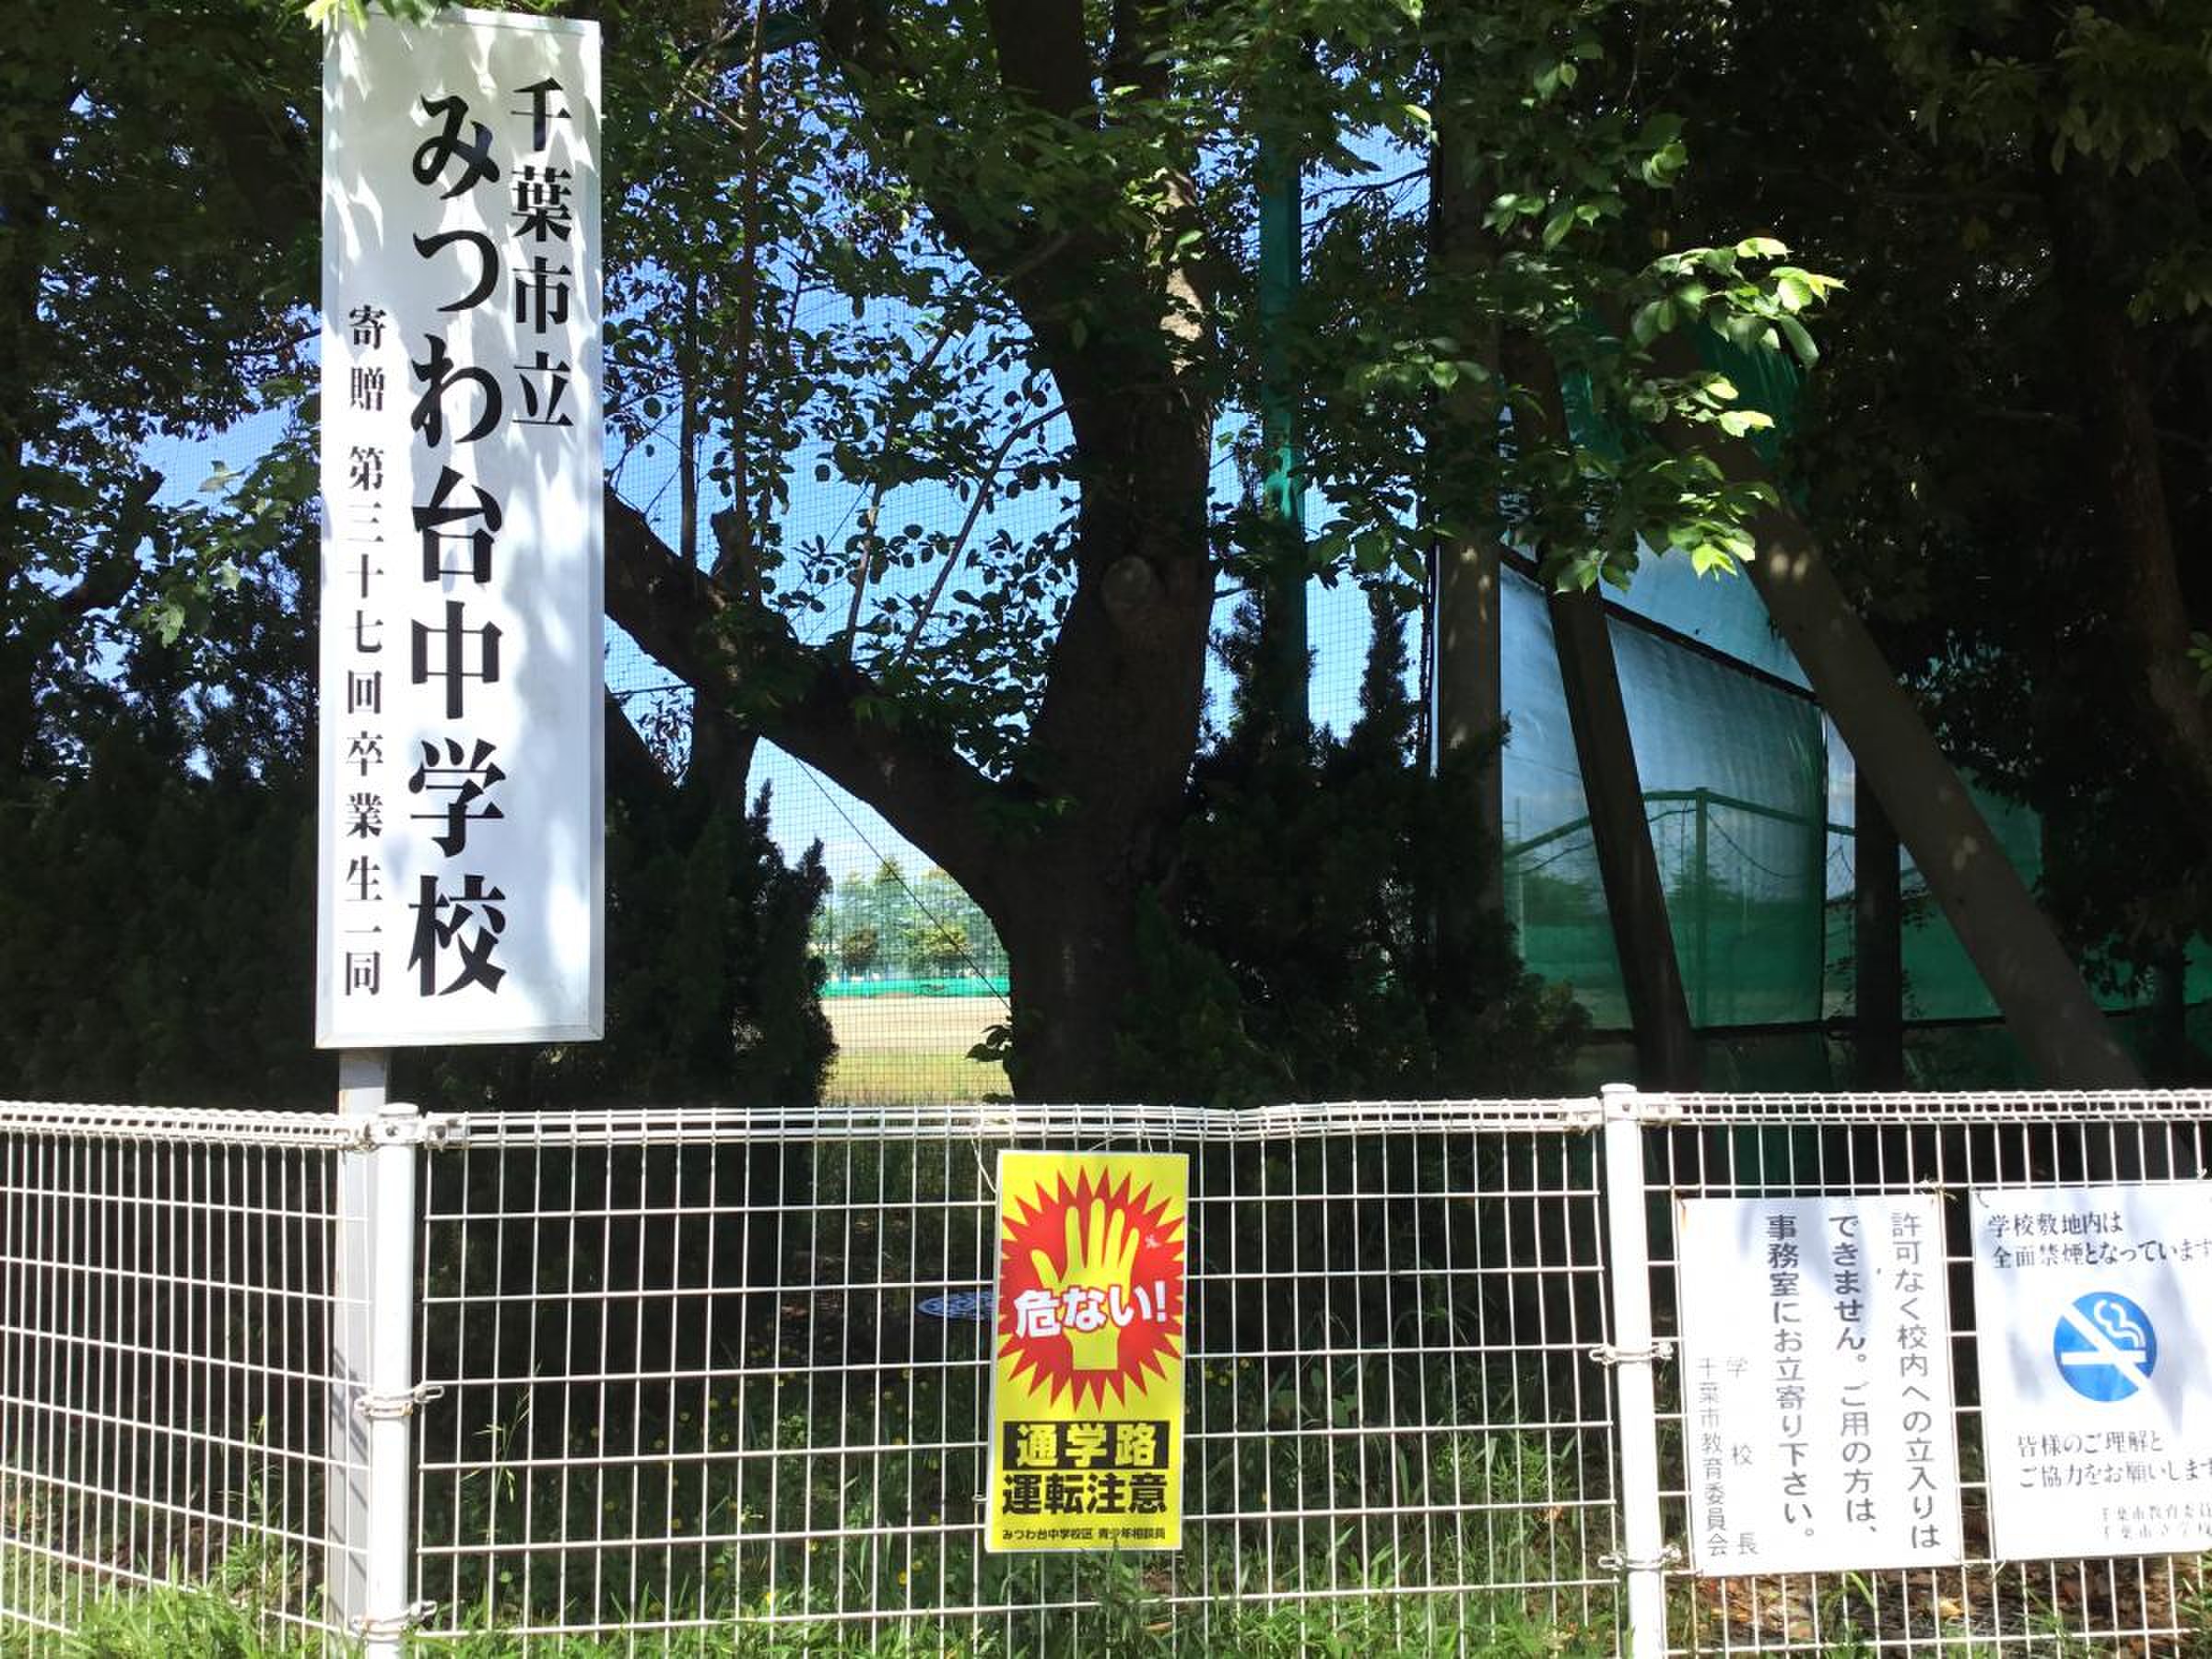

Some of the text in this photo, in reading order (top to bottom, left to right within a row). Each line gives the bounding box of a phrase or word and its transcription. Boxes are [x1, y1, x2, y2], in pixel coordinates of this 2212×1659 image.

[511, 76, 573, 428] 千葉市立
[345, 304, 387, 996] 寄贈 第三十七回卒業生一同
[406, 92, 506, 997] みつわ台中学校
[1988, 1211, 2124, 1238] 学校敷地内は
[1002, 1473, 1167, 1514] 運転注意
[1016, 1422, 1158, 1468] 通学路
[1697, 1357, 1728, 1556] 千葉市教育委員会
[1766, 1215, 1814, 1537] 事務室にお立寄り下さい。
[1891, 1212, 1940, 1548] 許可なく校内への立入りは
[2018, 1430, 2164, 1457] 皆様のご理解と
